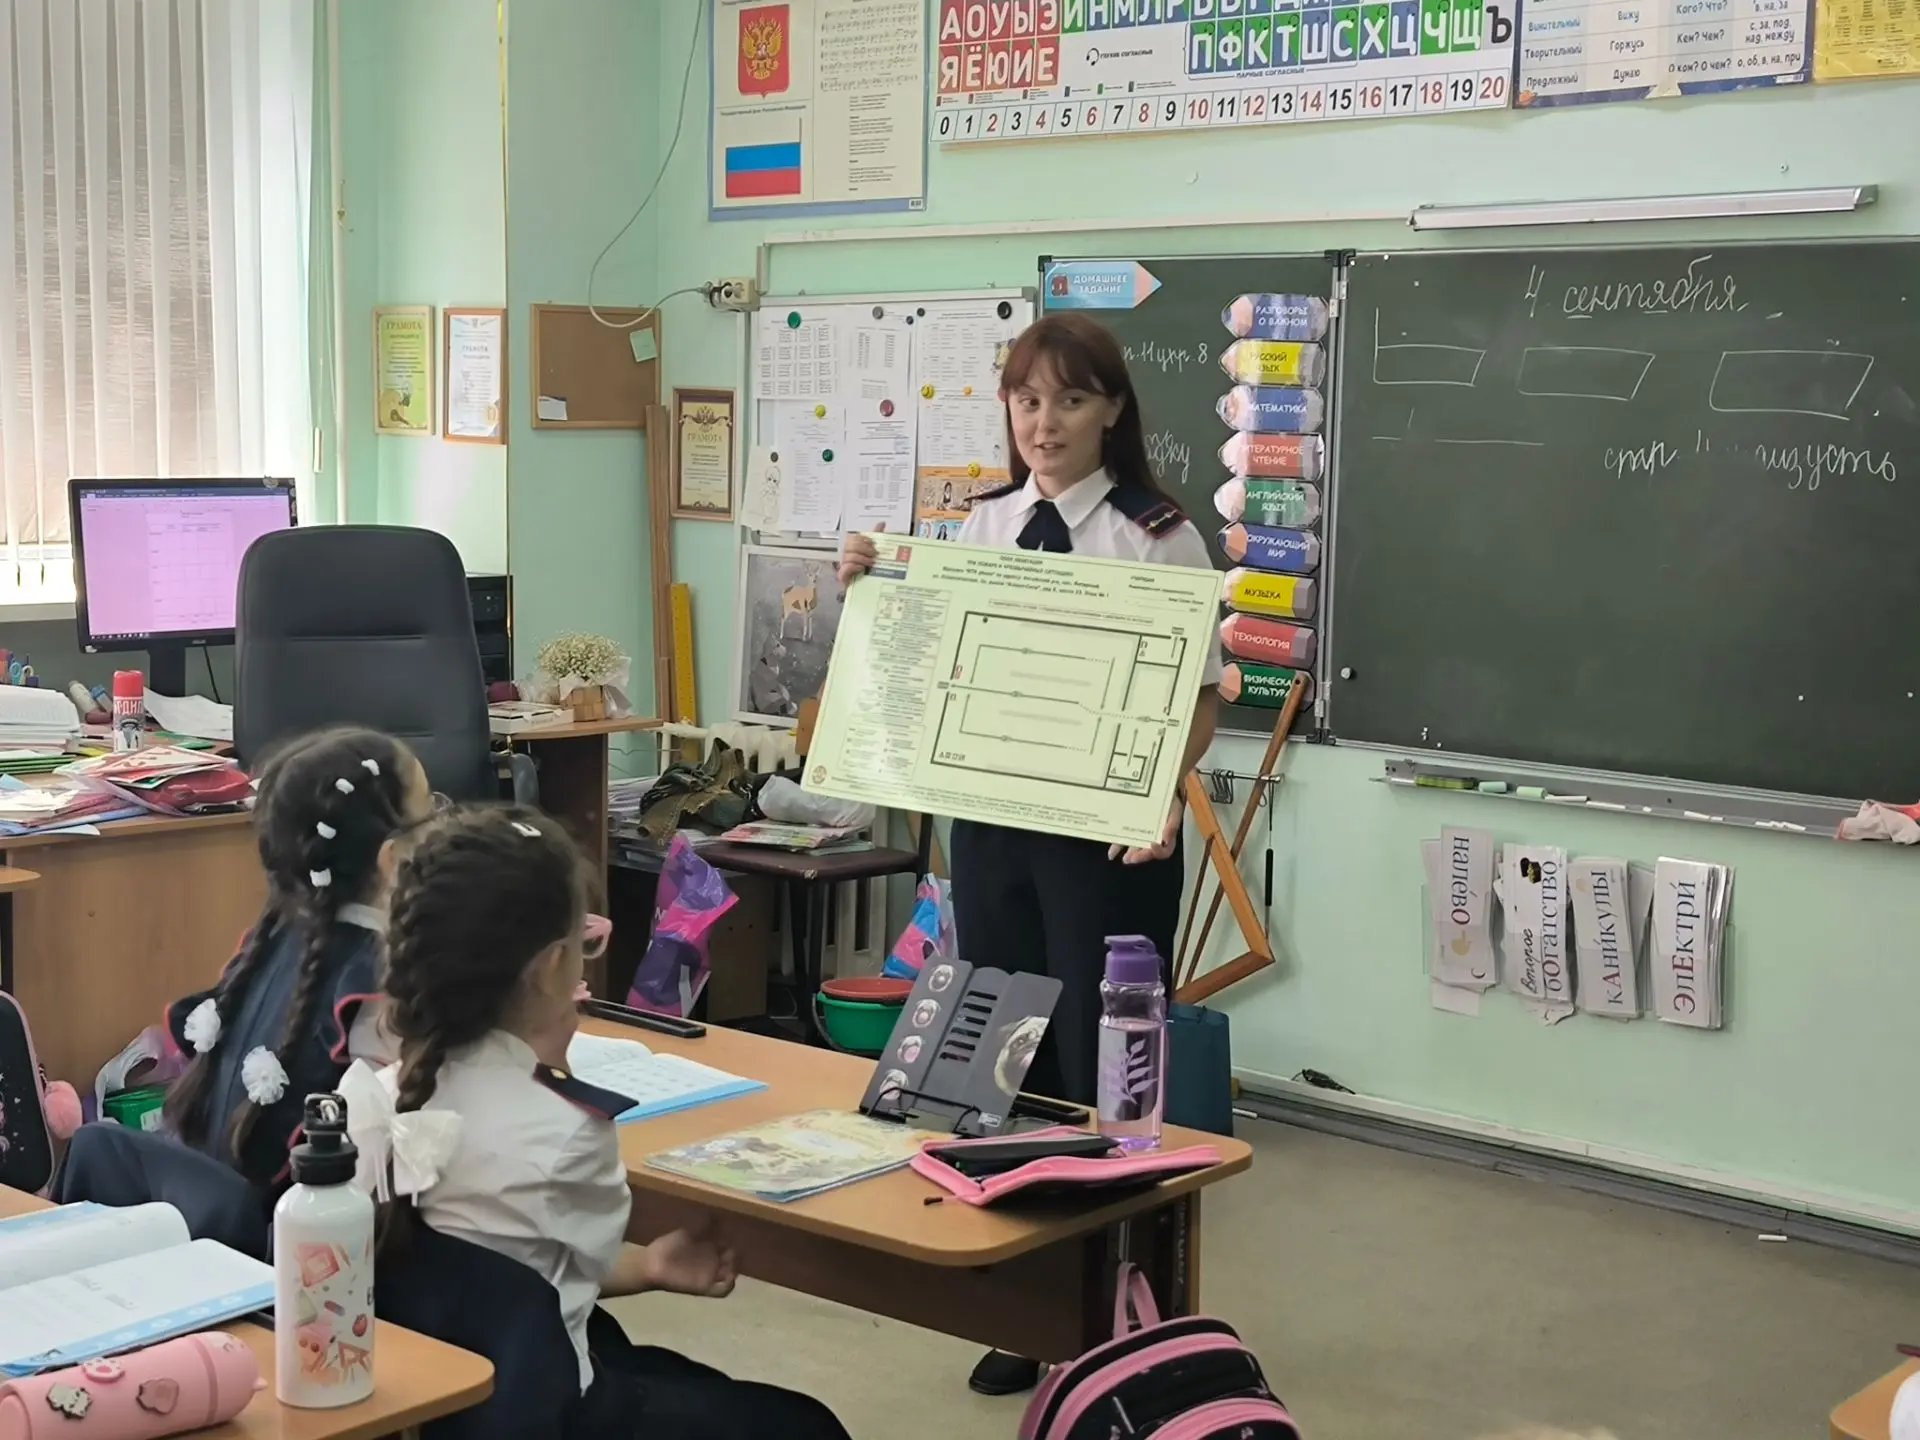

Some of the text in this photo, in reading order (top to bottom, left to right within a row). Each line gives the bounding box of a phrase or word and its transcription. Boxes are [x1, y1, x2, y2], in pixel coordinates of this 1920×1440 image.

[1676, 0, 1703, 15] Кого?
[1618, 9, 1640, 23] Вижу
[1528, 16, 1580, 32] Винительный
[1677, 29, 1725, 44] Кем? Чем?
[1525, 43, 1583, 60] Творительный
[1610, 40, 1645, 53] Горжусь
[1677, 60, 1699, 73] ком?
[1613, 69, 1641, 81] Думаю
[1526, 74, 1579, 91] Предложный
[940, 76, 1505, 135] 0 1 2 3 4 5 6 7 8 9 10 11 12 13 14 15 16 17 18 19 20
[1073, 273, 1128, 284] ДОМАШНЕЕ
[1198, 343, 1208, 364] 8
[1267, 548, 1287, 558] МИР
[1244, 588, 1281, 600] МУЗЫКА
[1233, 632, 1290, 649] ТЕХНОЛОГИЯ
[1243, 674, 1293, 687] ФИЗИЧЕСКА
